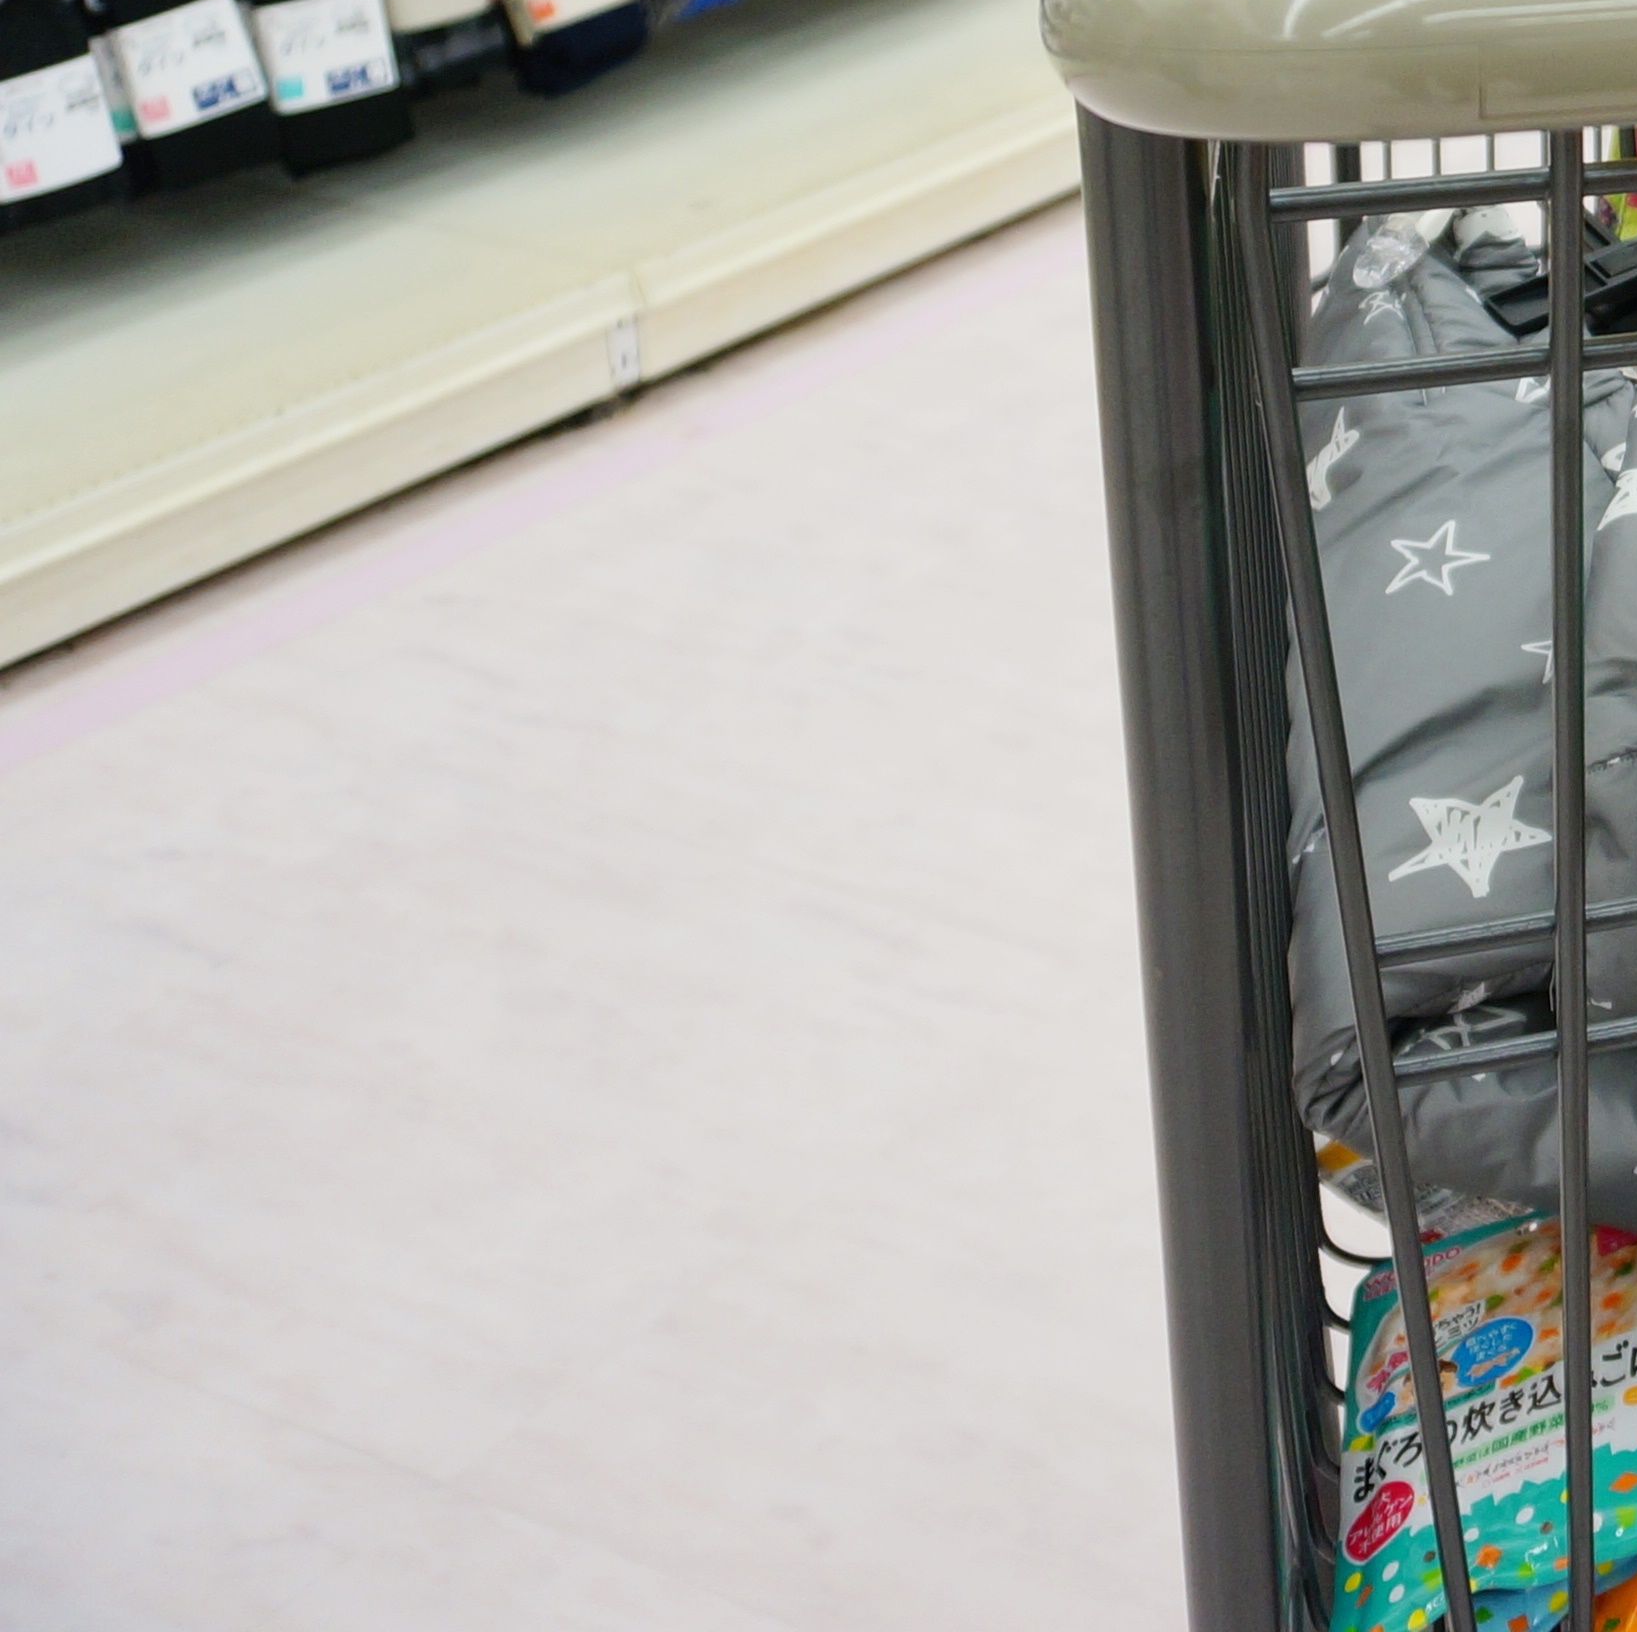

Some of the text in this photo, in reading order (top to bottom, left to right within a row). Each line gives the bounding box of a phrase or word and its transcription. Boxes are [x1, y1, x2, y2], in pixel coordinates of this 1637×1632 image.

[1433, 1301, 1483, 1331] ちゃう!
[1358, 1514, 1403, 1554] 不使用
